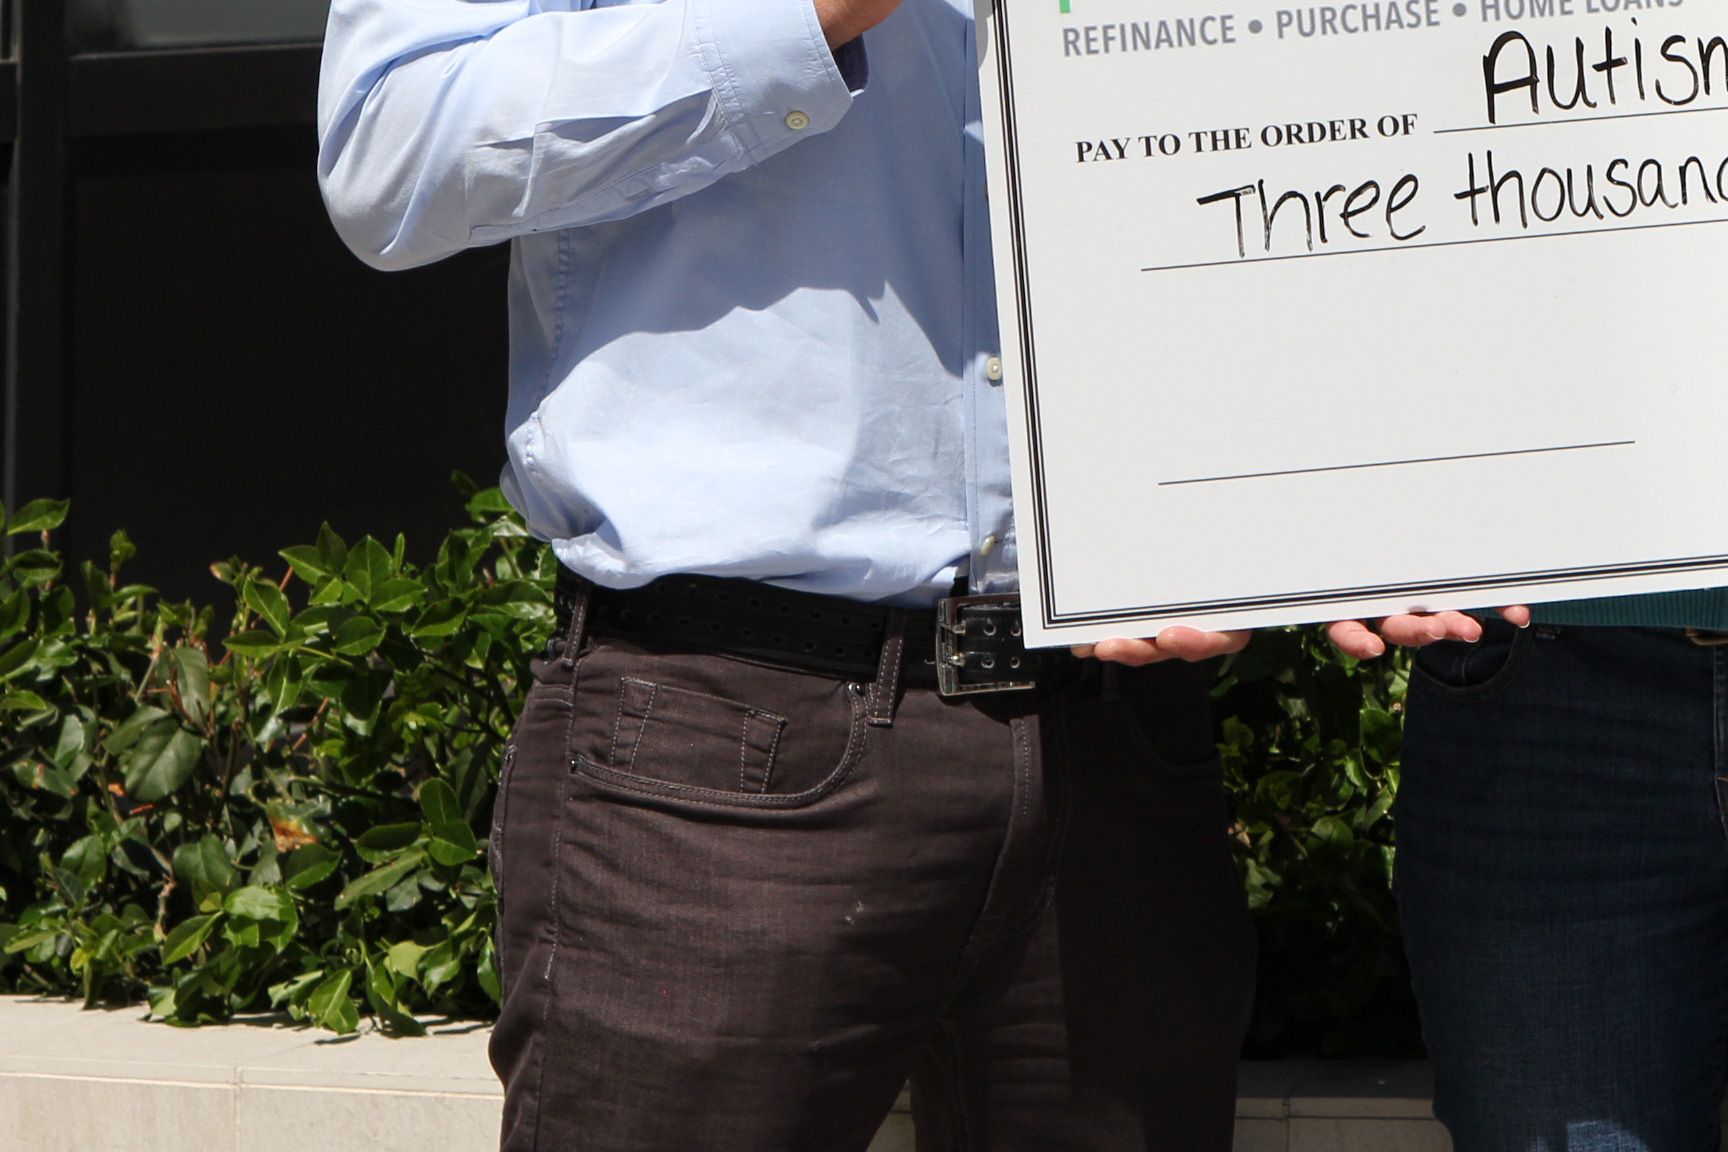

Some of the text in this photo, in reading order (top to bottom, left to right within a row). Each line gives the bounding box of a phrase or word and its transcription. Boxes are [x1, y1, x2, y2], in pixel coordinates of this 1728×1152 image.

[1063, 14, 1236, 57] REFINANCE
[1075, 114, 1418, 163] PAY TO THE ORDER OF
[1197, 172, 1426, 259] Three
